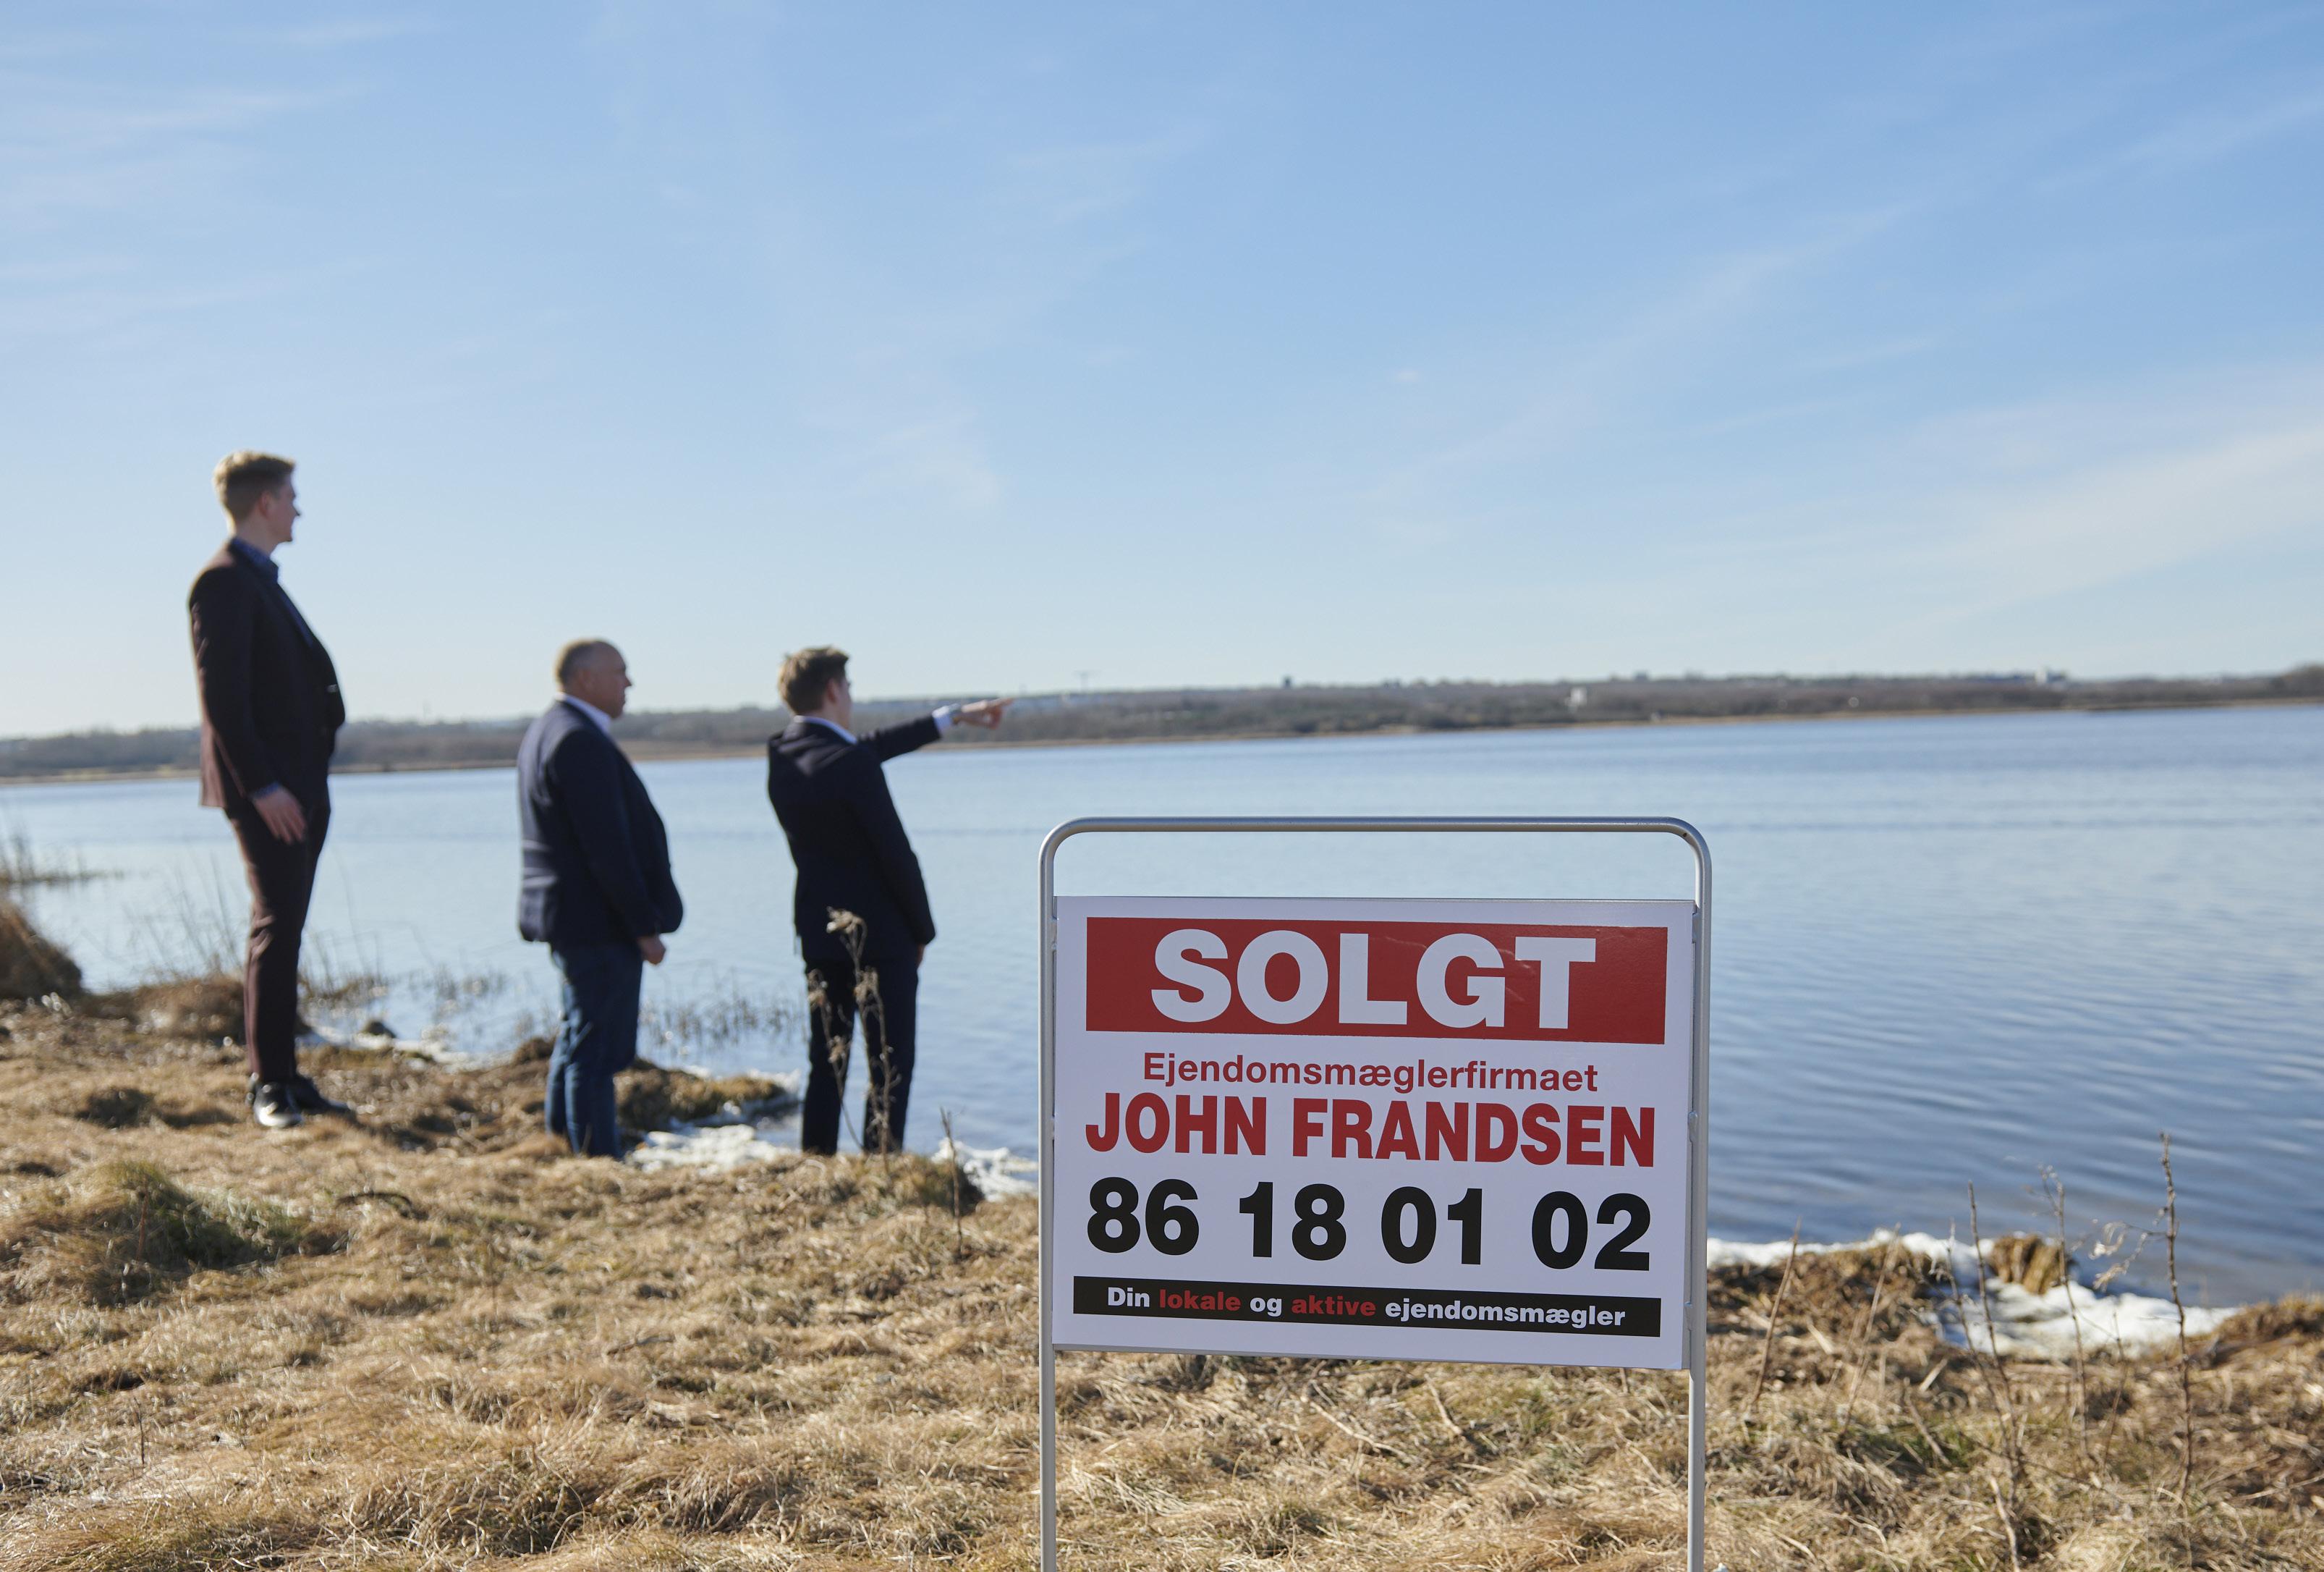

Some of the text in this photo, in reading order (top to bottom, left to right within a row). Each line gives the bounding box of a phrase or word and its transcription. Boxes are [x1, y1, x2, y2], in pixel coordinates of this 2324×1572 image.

[1151, 929, 1596, 1028] SOLGT
[1143, 1052, 1598, 1092] Ejendomsmæglerfirmaet
[1086, 1093, 1655, 1167] JOHN FRANDSEN
[1087, 1177, 1650, 1271] 86 18 01 02
[1108, 1288, 1626, 1327] Din lokale og aktive ejendomsmægler
